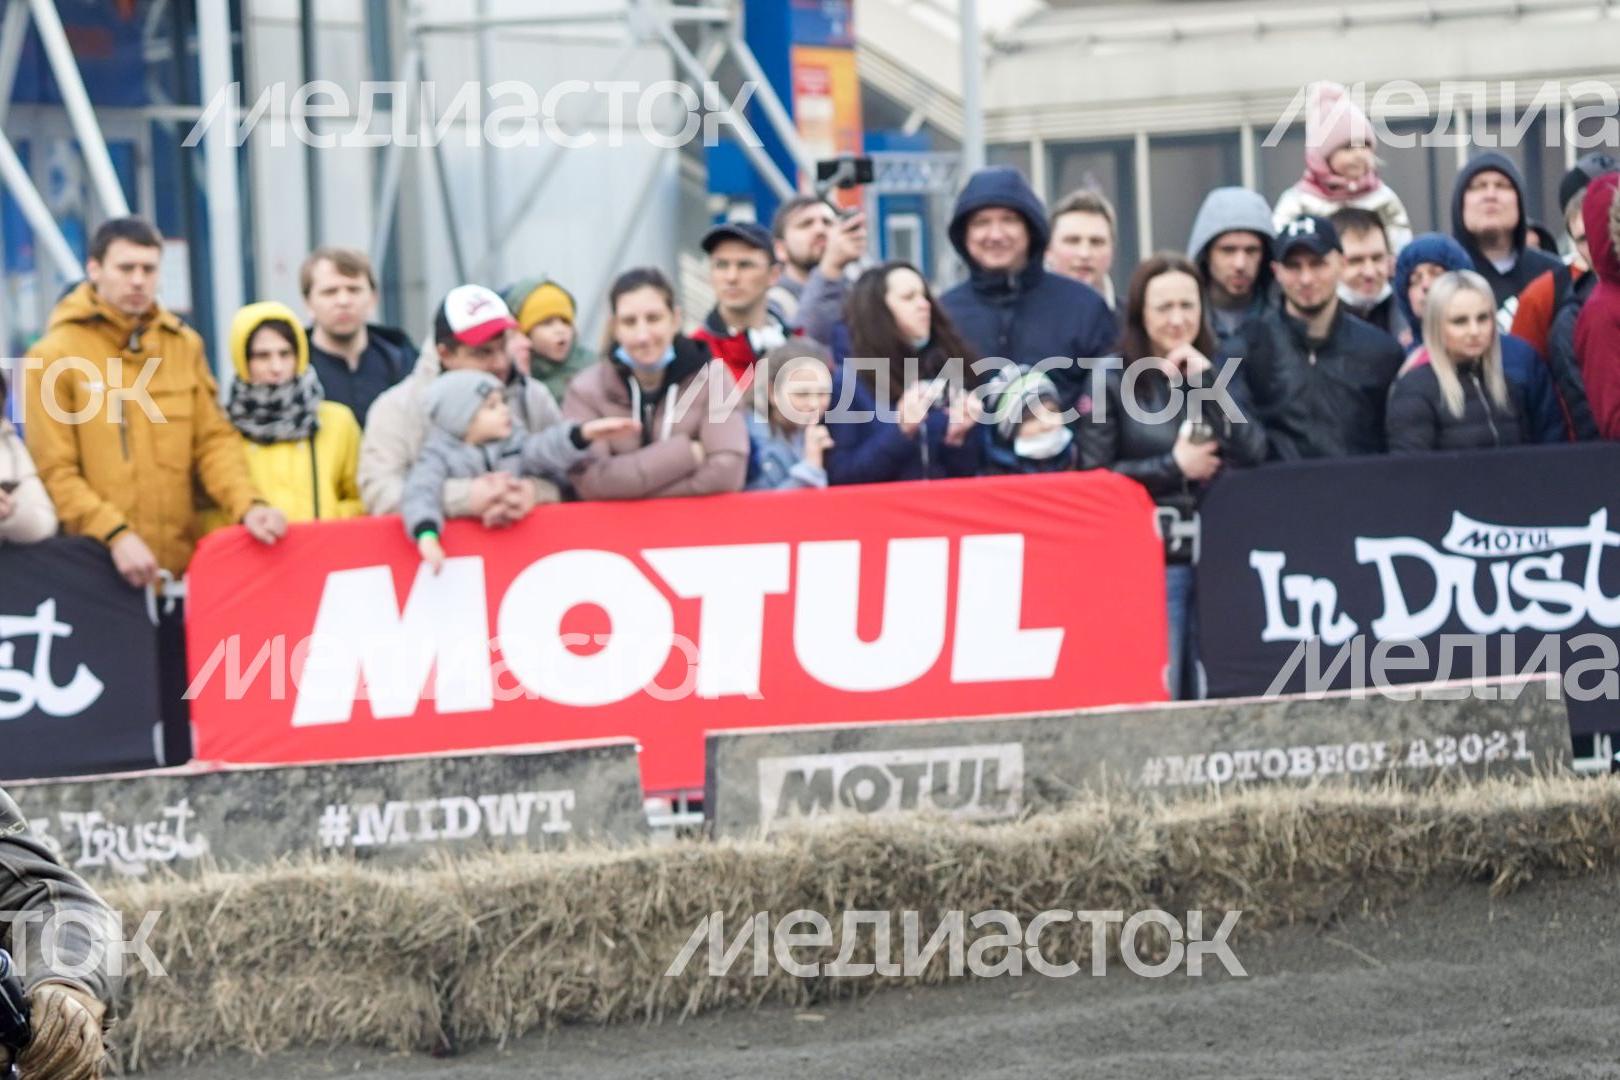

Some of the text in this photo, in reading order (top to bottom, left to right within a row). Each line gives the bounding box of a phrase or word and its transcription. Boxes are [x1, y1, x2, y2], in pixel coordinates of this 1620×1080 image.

[1456, 528, 1556, 551] MOTUL
[1248, 548, 1359, 646] In
[291, 532, 1065, 727] MOTUL
[776, 757, 1013, 818] MOTUL
[317, 789, 576, 848] #MIDWT
